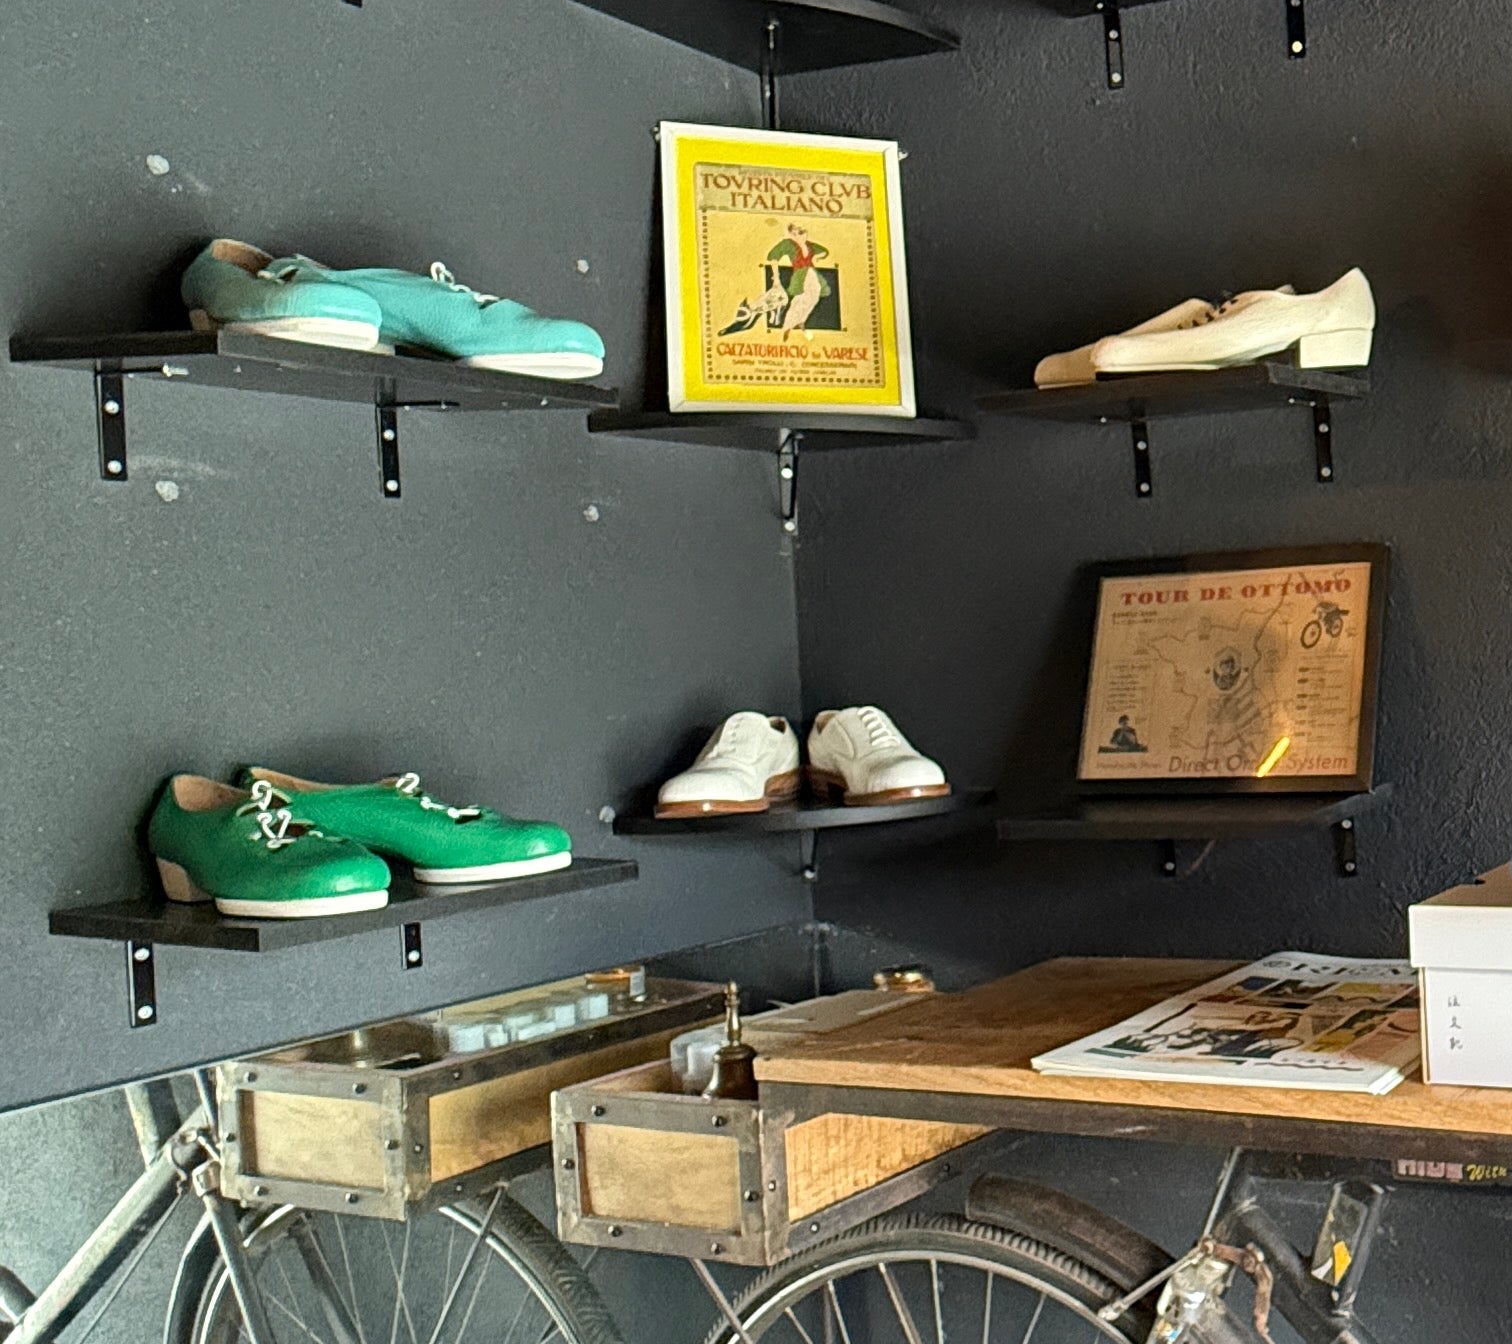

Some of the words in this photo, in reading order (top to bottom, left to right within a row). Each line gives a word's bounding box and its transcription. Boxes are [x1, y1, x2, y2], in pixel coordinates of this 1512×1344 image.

[703, 173, 804, 195] TOVRING
[810, 181, 872, 200] CLVB
[730, 191, 844, 214] ITALIANO
[823, 346, 869, 361] VARESE
[1122, 589, 1189, 606] TOUR
[1200, 586, 1232, 601] DE
[1241, 578, 1351, 599] OTTOMO
[1168, 755, 1219, 773] Direct
[1284, 754, 1349, 774] System
